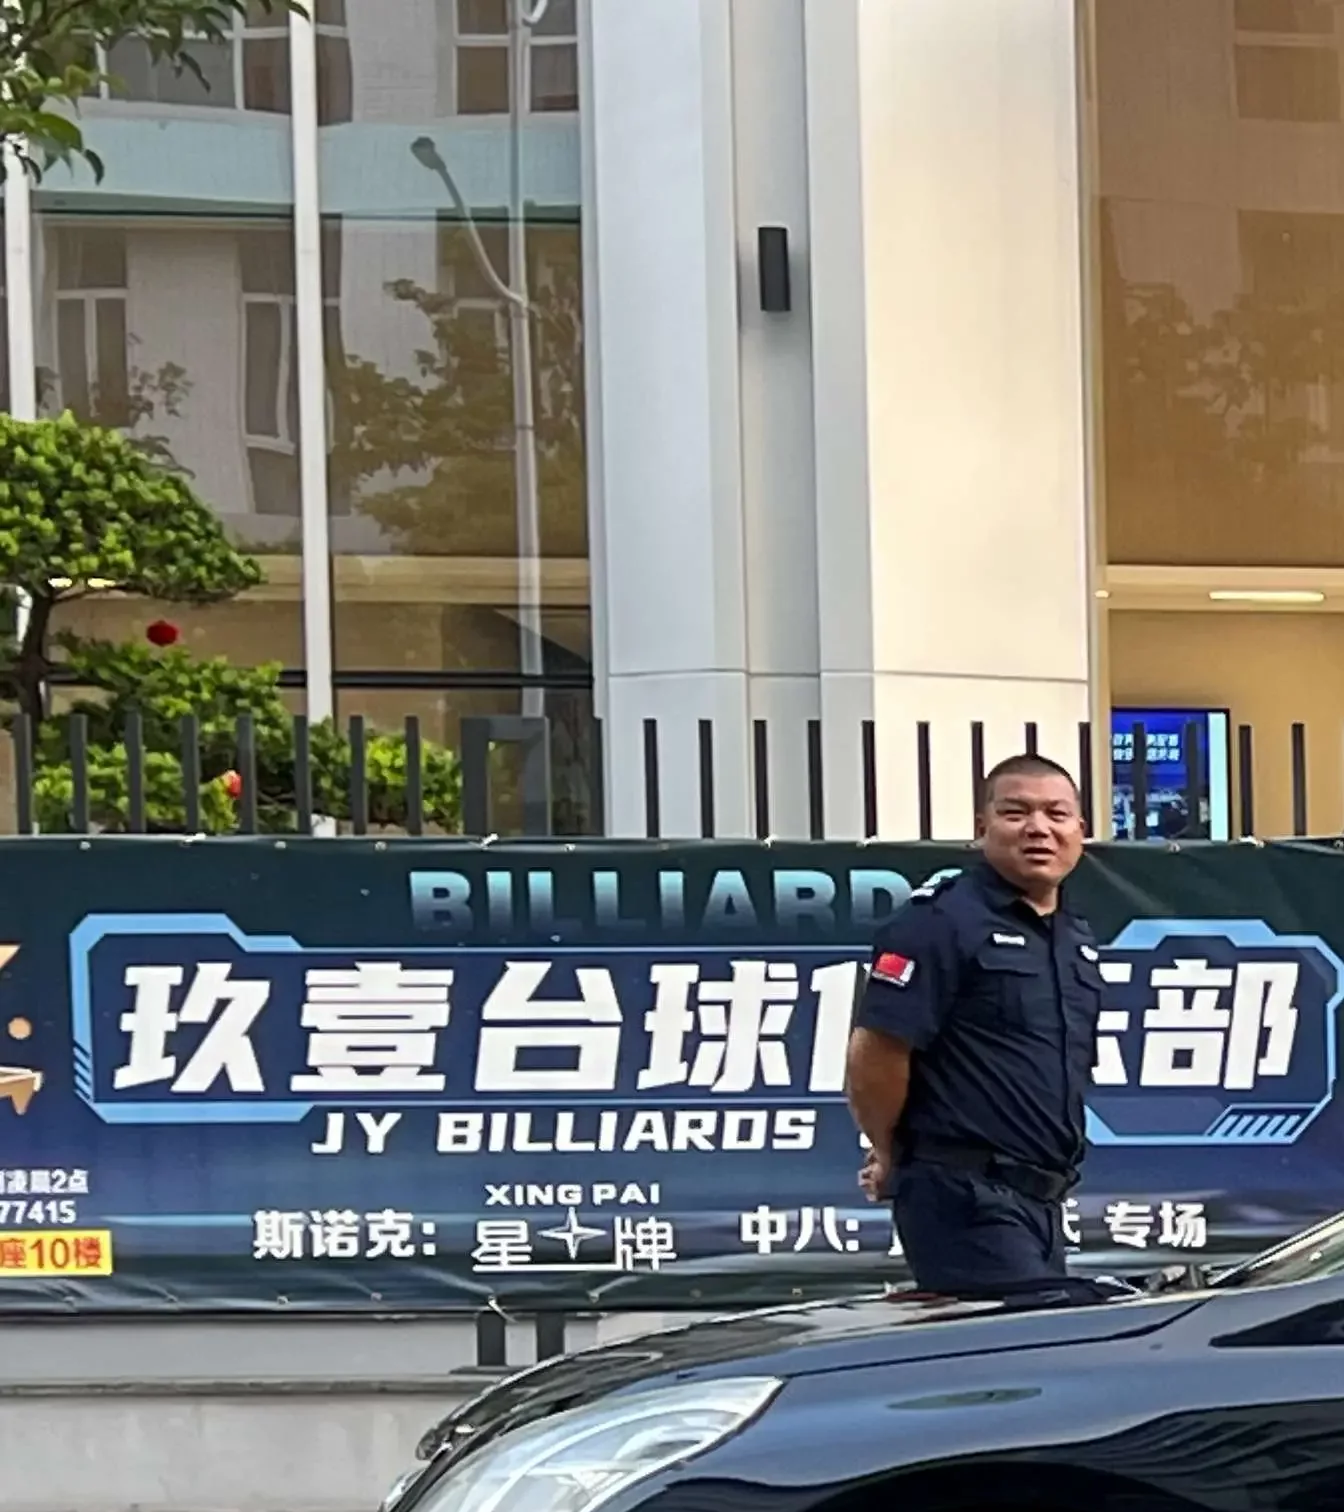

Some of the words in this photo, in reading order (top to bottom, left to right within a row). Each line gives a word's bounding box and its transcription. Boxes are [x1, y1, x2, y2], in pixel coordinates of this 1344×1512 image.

[408, 869, 963, 934] BILLIARD
[113, 960, 1299, 1093] 玖壹台球部
[311, 1110, 402, 1154] JY
[436, 1109, 817, 1153] BILLIARDS
[485, 1184, 581, 1205] XING
[591, 1183, 661, 1205] PAI
